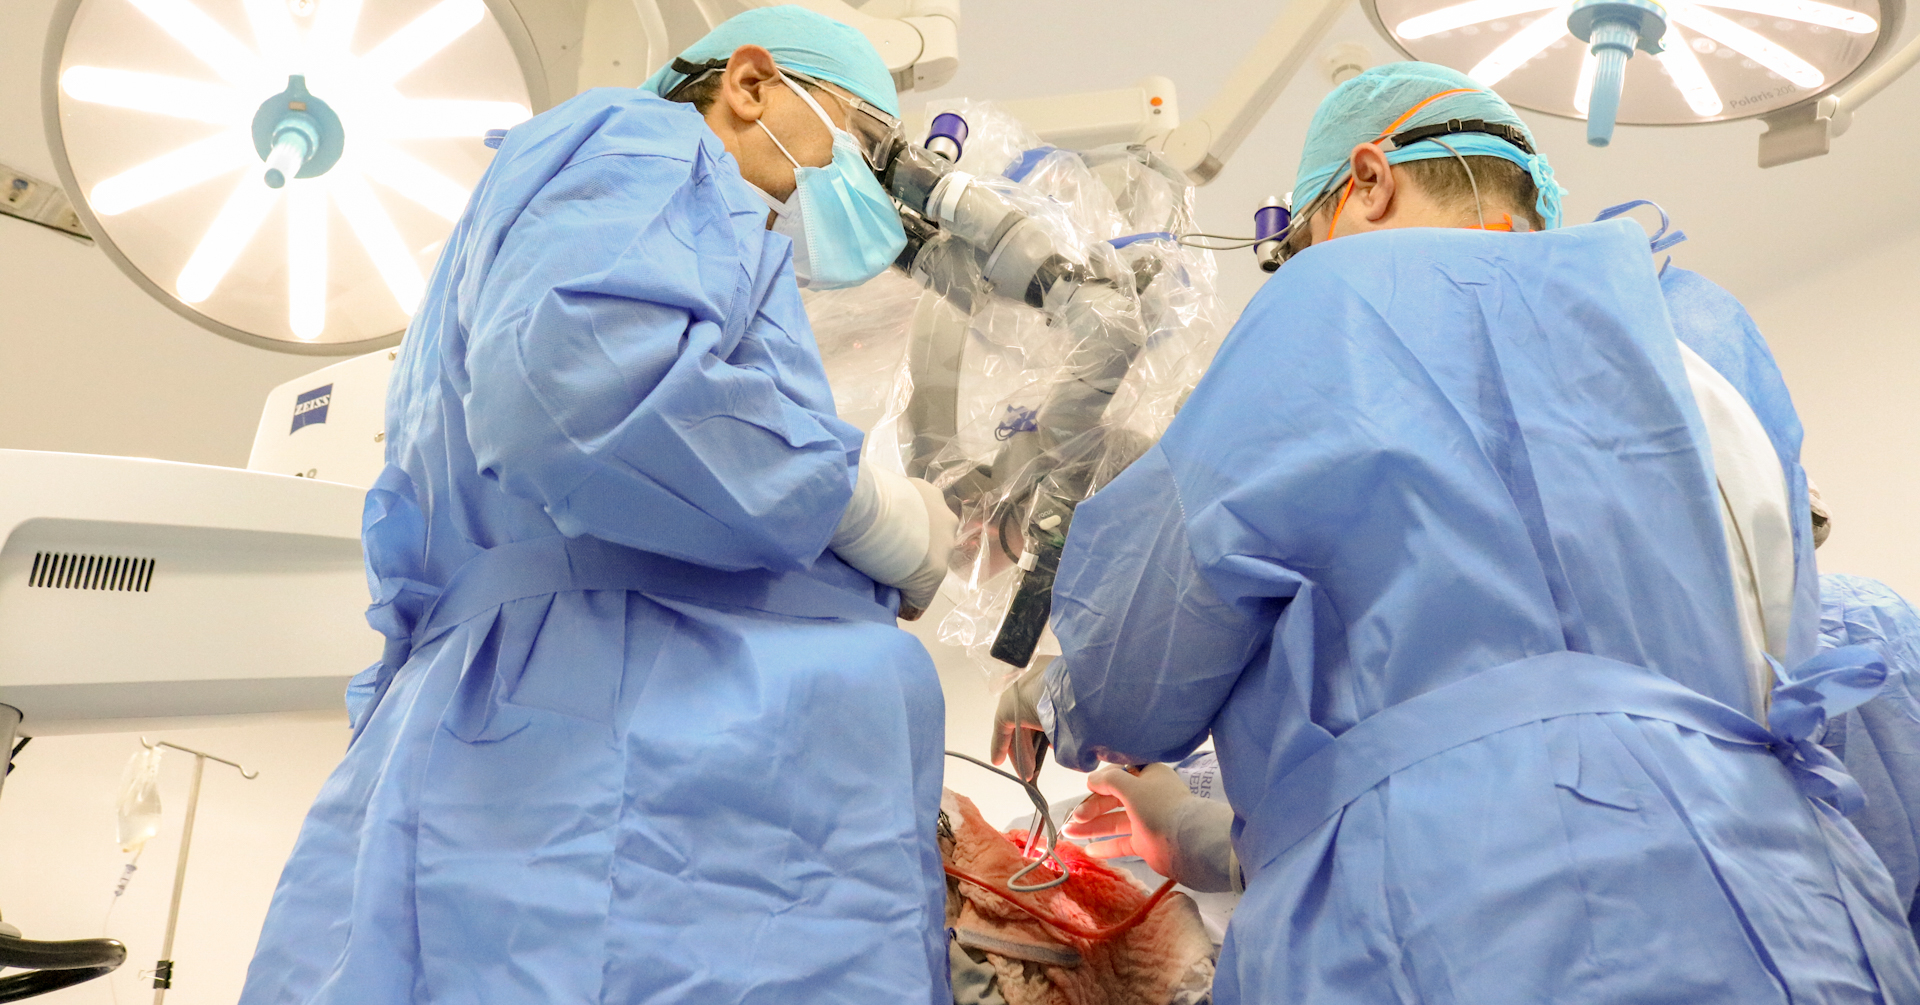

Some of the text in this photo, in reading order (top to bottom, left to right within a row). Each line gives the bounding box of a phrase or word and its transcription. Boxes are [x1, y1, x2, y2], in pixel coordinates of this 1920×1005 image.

[1729, 84, 1796, 109] Polaris 200
[294, 394, 330, 416] ZEISS
